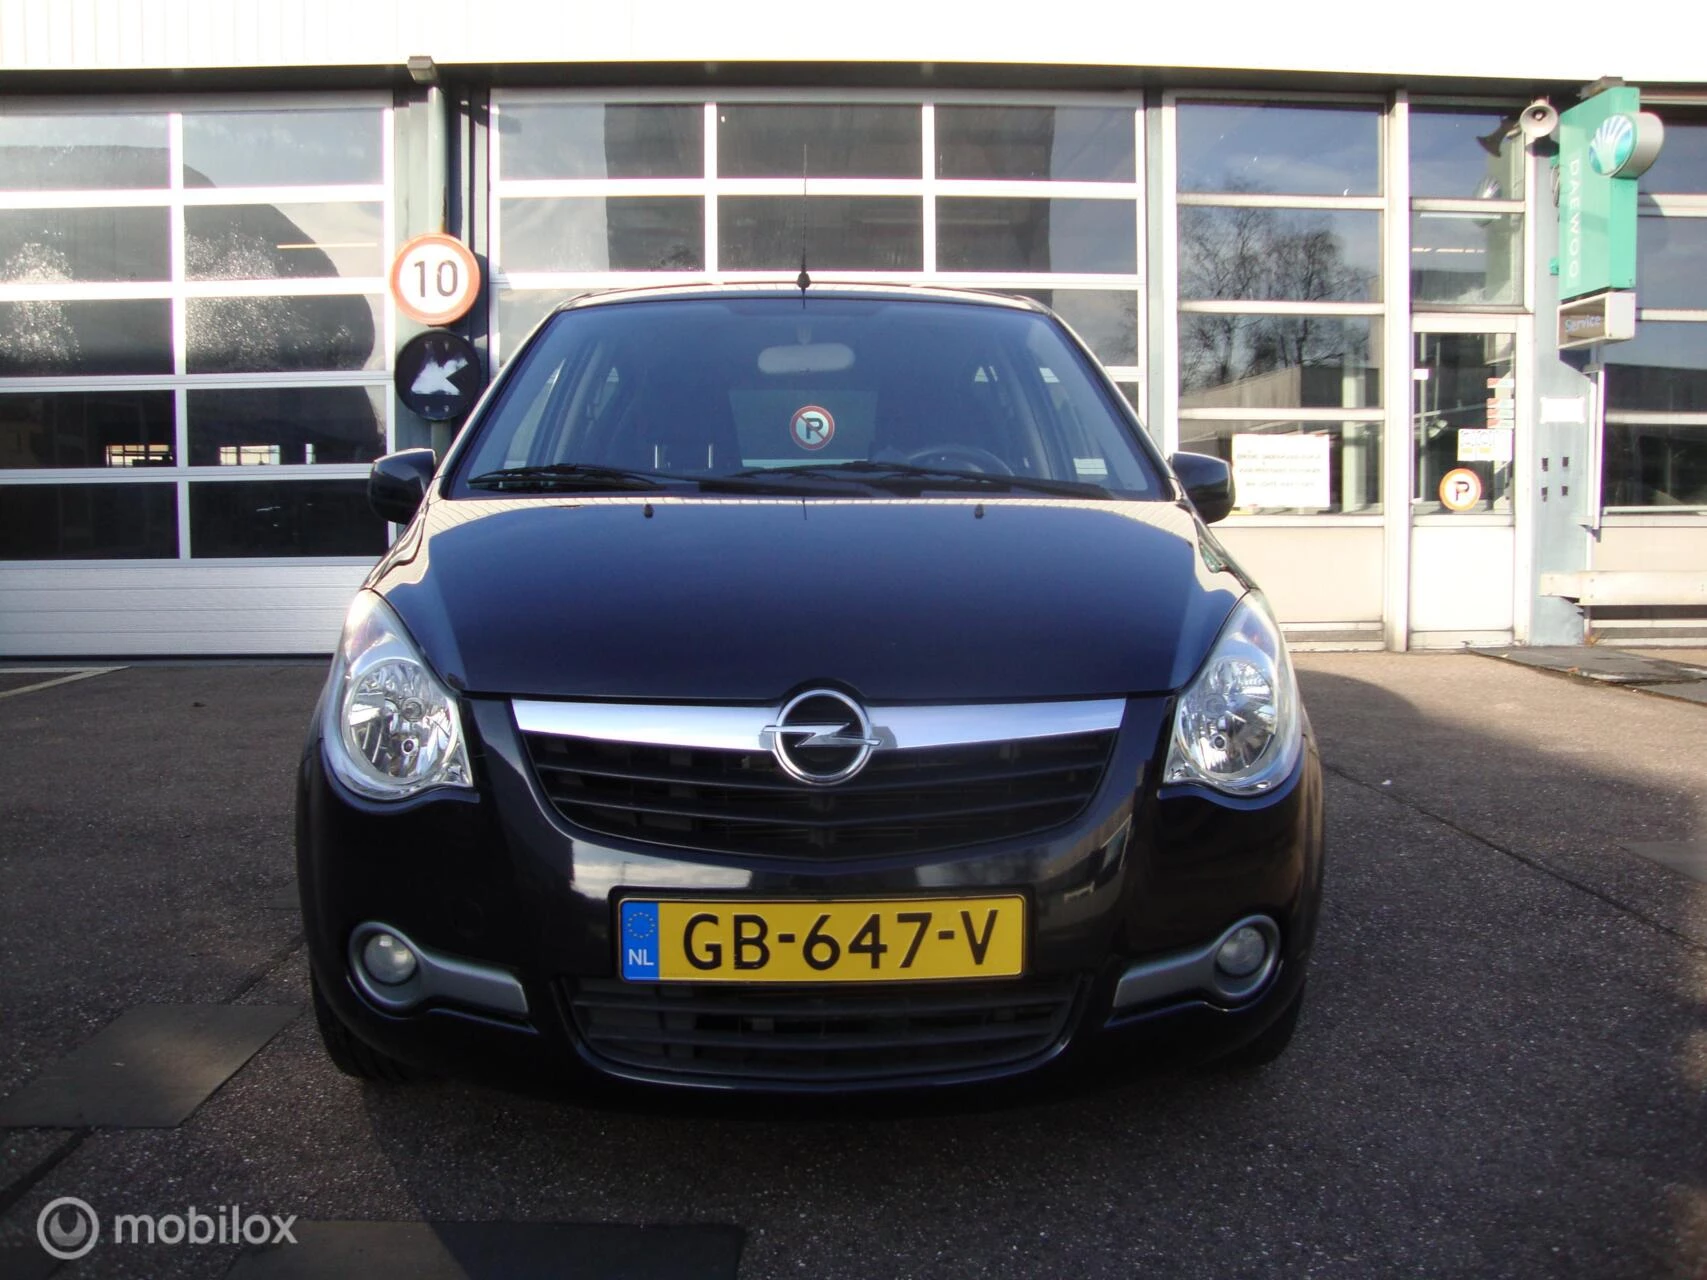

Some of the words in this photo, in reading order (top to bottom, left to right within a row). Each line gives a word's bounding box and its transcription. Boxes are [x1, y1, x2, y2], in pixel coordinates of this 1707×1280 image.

[1569, 159, 1582, 278] DAEWOO
[414, 260, 458, 297] 10
[806, 418, 823, 439] P
[629, 949, 654, 966] NL
[682, 909, 1000, 972] GB-647-V
